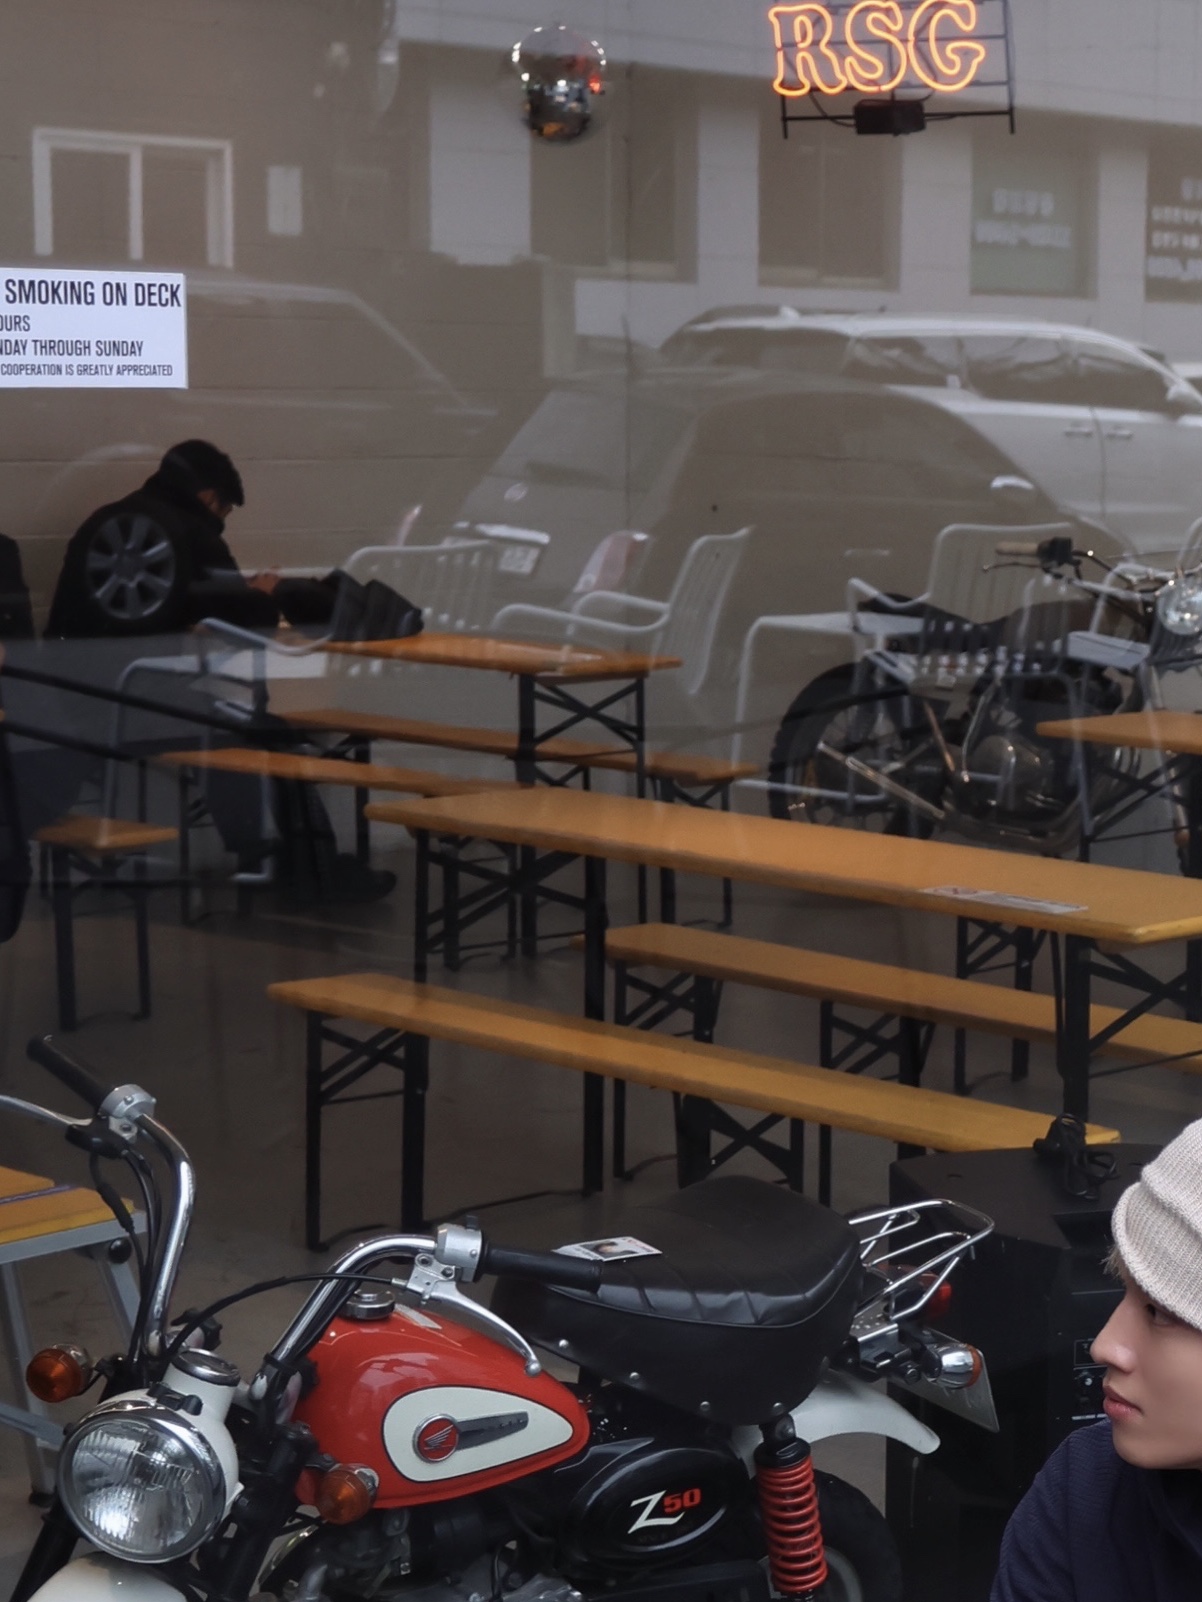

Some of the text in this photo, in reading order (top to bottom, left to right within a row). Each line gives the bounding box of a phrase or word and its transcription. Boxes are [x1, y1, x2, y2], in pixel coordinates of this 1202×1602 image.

[767, 0, 986, 97] RSG
[5, 278, 182, 307] SMOKING ON DECK
[32, 339, 91, 356] THROUGH
[95, 340, 144, 357] SUNDAY
[1, 363, 173, 377] COOPERATION IS GREATLY APPRECIATED
[627, 1487, 702, 1535] Z50
